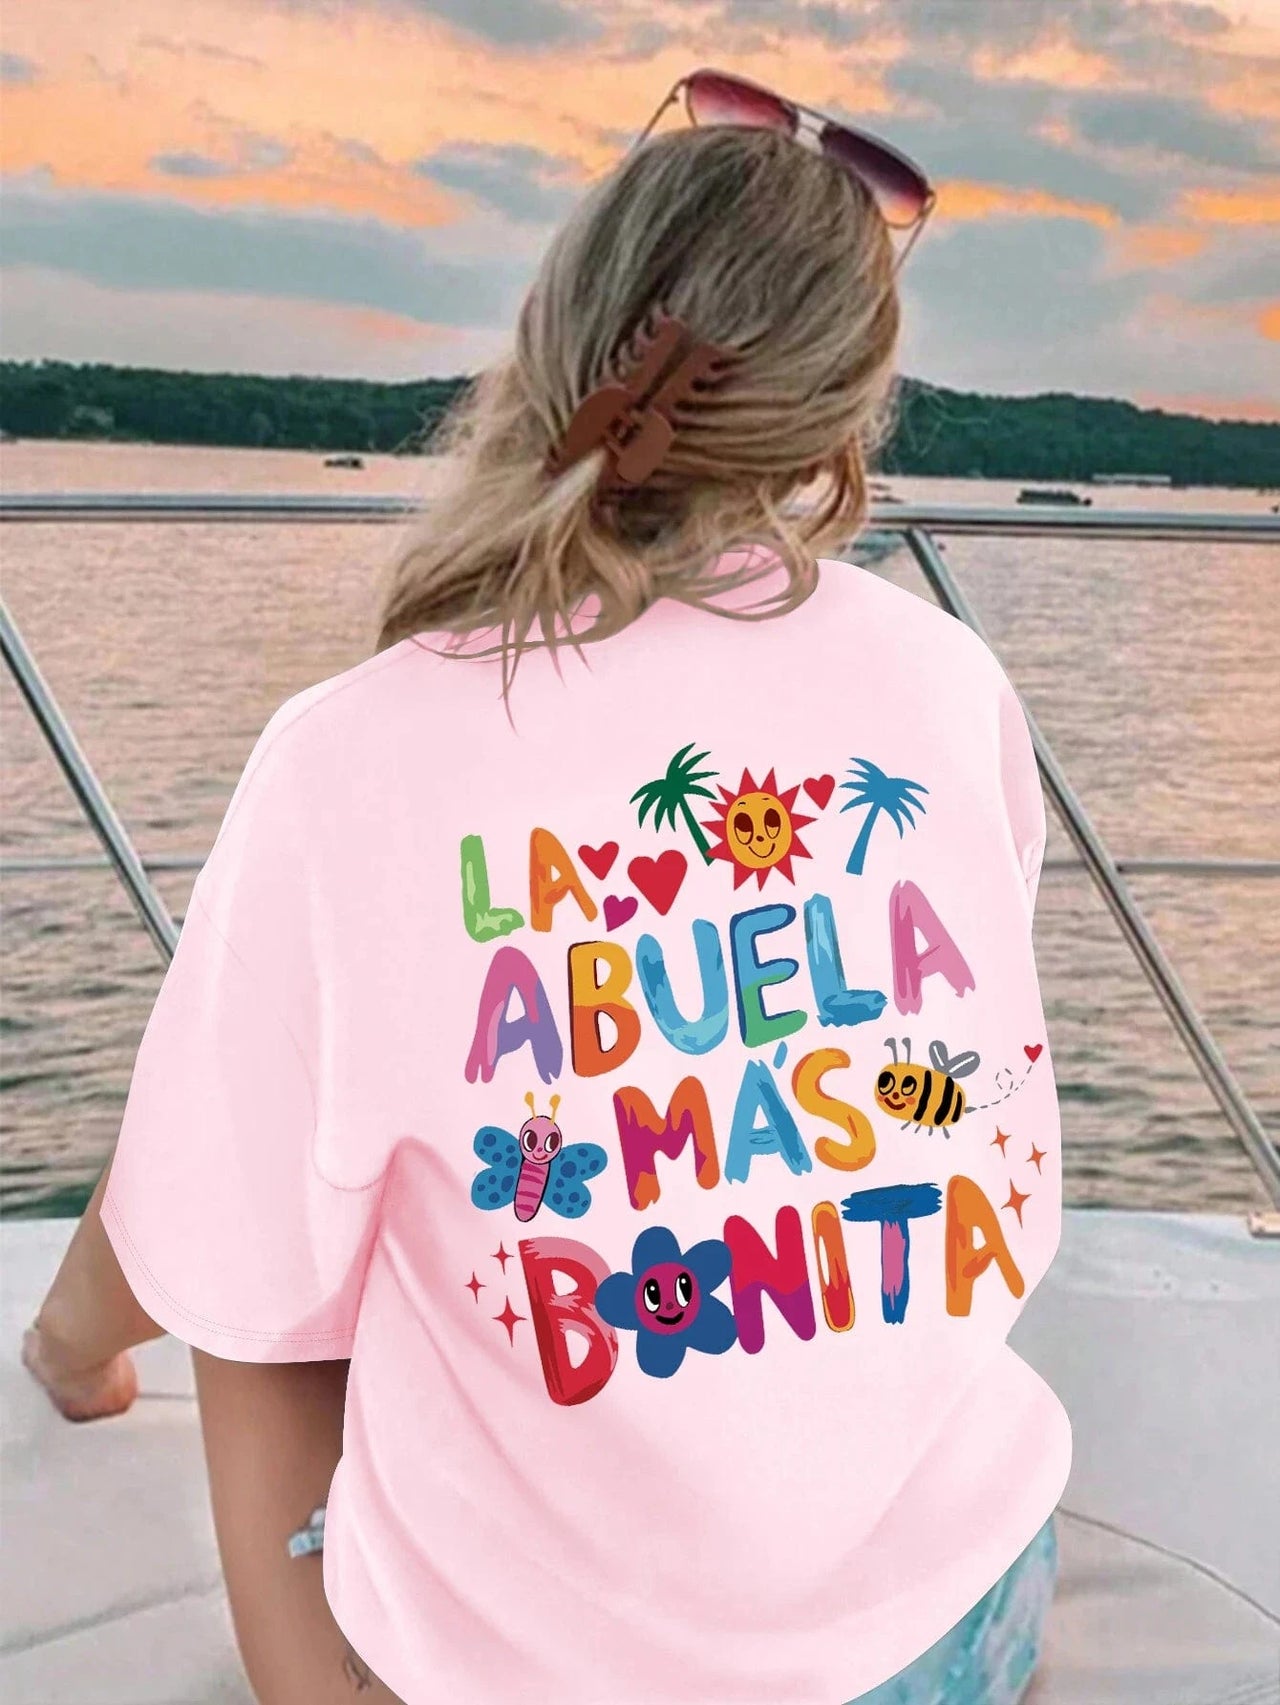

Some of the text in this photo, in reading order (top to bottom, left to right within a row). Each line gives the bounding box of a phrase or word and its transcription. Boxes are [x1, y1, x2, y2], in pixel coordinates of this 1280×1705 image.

[460, 827, 598, 943] LA
[464, 880, 976, 1085] ABUELA
[613, 1041, 876, 1211] MÁS
